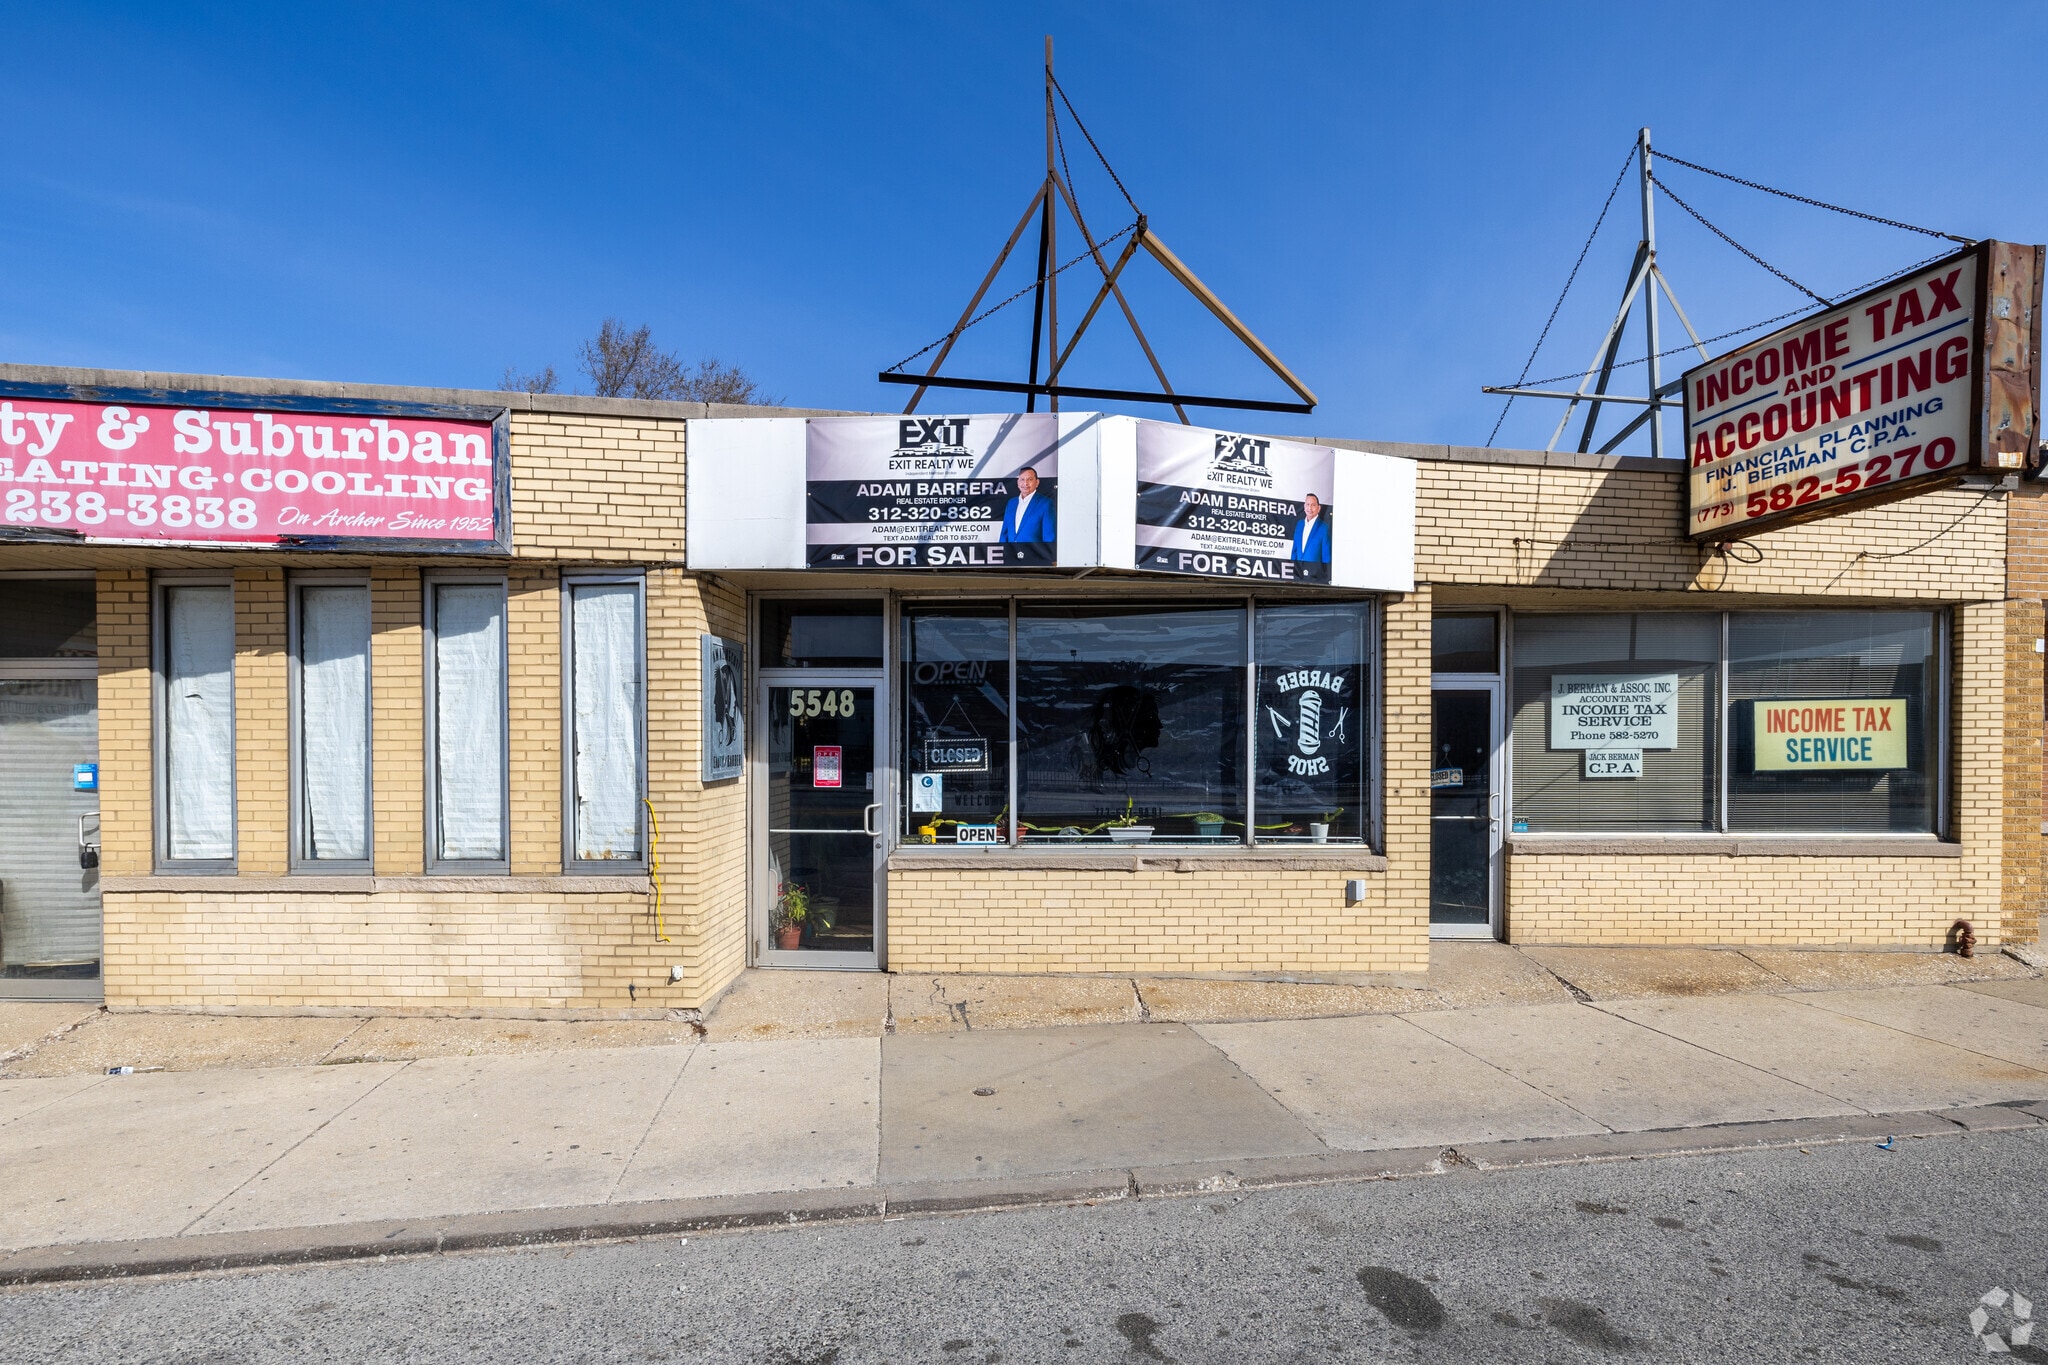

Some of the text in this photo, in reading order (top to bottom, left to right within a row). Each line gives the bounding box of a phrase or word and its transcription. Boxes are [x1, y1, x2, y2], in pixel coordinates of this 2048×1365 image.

[1695, 268, 1962, 412] INCOME TAX
[1783, 364, 1836, 397] AND
[1692, 335, 1969, 468] ACCOUNTING
[97, 406, 150, 450] &
[173, 410, 491, 466] Suburban
[1706, 397, 1943, 484] FINANCIAL PLANNING
[889, 459, 974, 470] EXIT REALTY WE
[1722, 424, 1917, 493] J. BERMAN C.P.A.
[1207, 471, 1273, 488] EXIT REALTY WE
[1697, 437, 1956, 524] (773) 582-5270
[856, 482, 1008, 497] ADAM BARRERA
[5, 488, 258, 530] 238-3838
[1179, 490, 1297, 516] ADAM BARRERA
[278, 507, 492, 532] On Archer Since 1952
[868, 506, 992, 520] 312-320-8362
[1211, 508, 1267, 520] REAL ESTATE BROKER
[872, 525, 990, 534] ADAM@EXITREALTYWE.COM
[1188, 515, 1286, 537] 312-320-8362
[1191, 533, 1284, 548] ADAM@EXITREALTYWE.COM
[1214, 544, 1253, 553] ADAMREALTOR
[857, 546, 1005, 565] FOR SALE
[1178, 552, 1295, 580] FOR SALE
[914, 660, 988, 685] OPEN
[1557, 682, 1672, 694] J. BERMAN & ASSOC. INC.
[789, 689, 855, 718] 5548
[1579, 695, 1652, 703] ACCOUNTANTS
[1562, 704, 1668, 716] INCOME TAX
[1578, 716, 1652, 727] SERVICE
[1767, 707, 1892, 734] INCOME TAX
[1570, 730, 1659, 740] Phone 582-5270
[931, 747, 981, 763] CLOSED
[1589, 752, 1640, 761] JACK BERMAN
[1786, 737, 1872, 763] SERVICE
[1589, 763, 1640, 774] C.P.A.
[959, 828, 995, 842] OPEN
